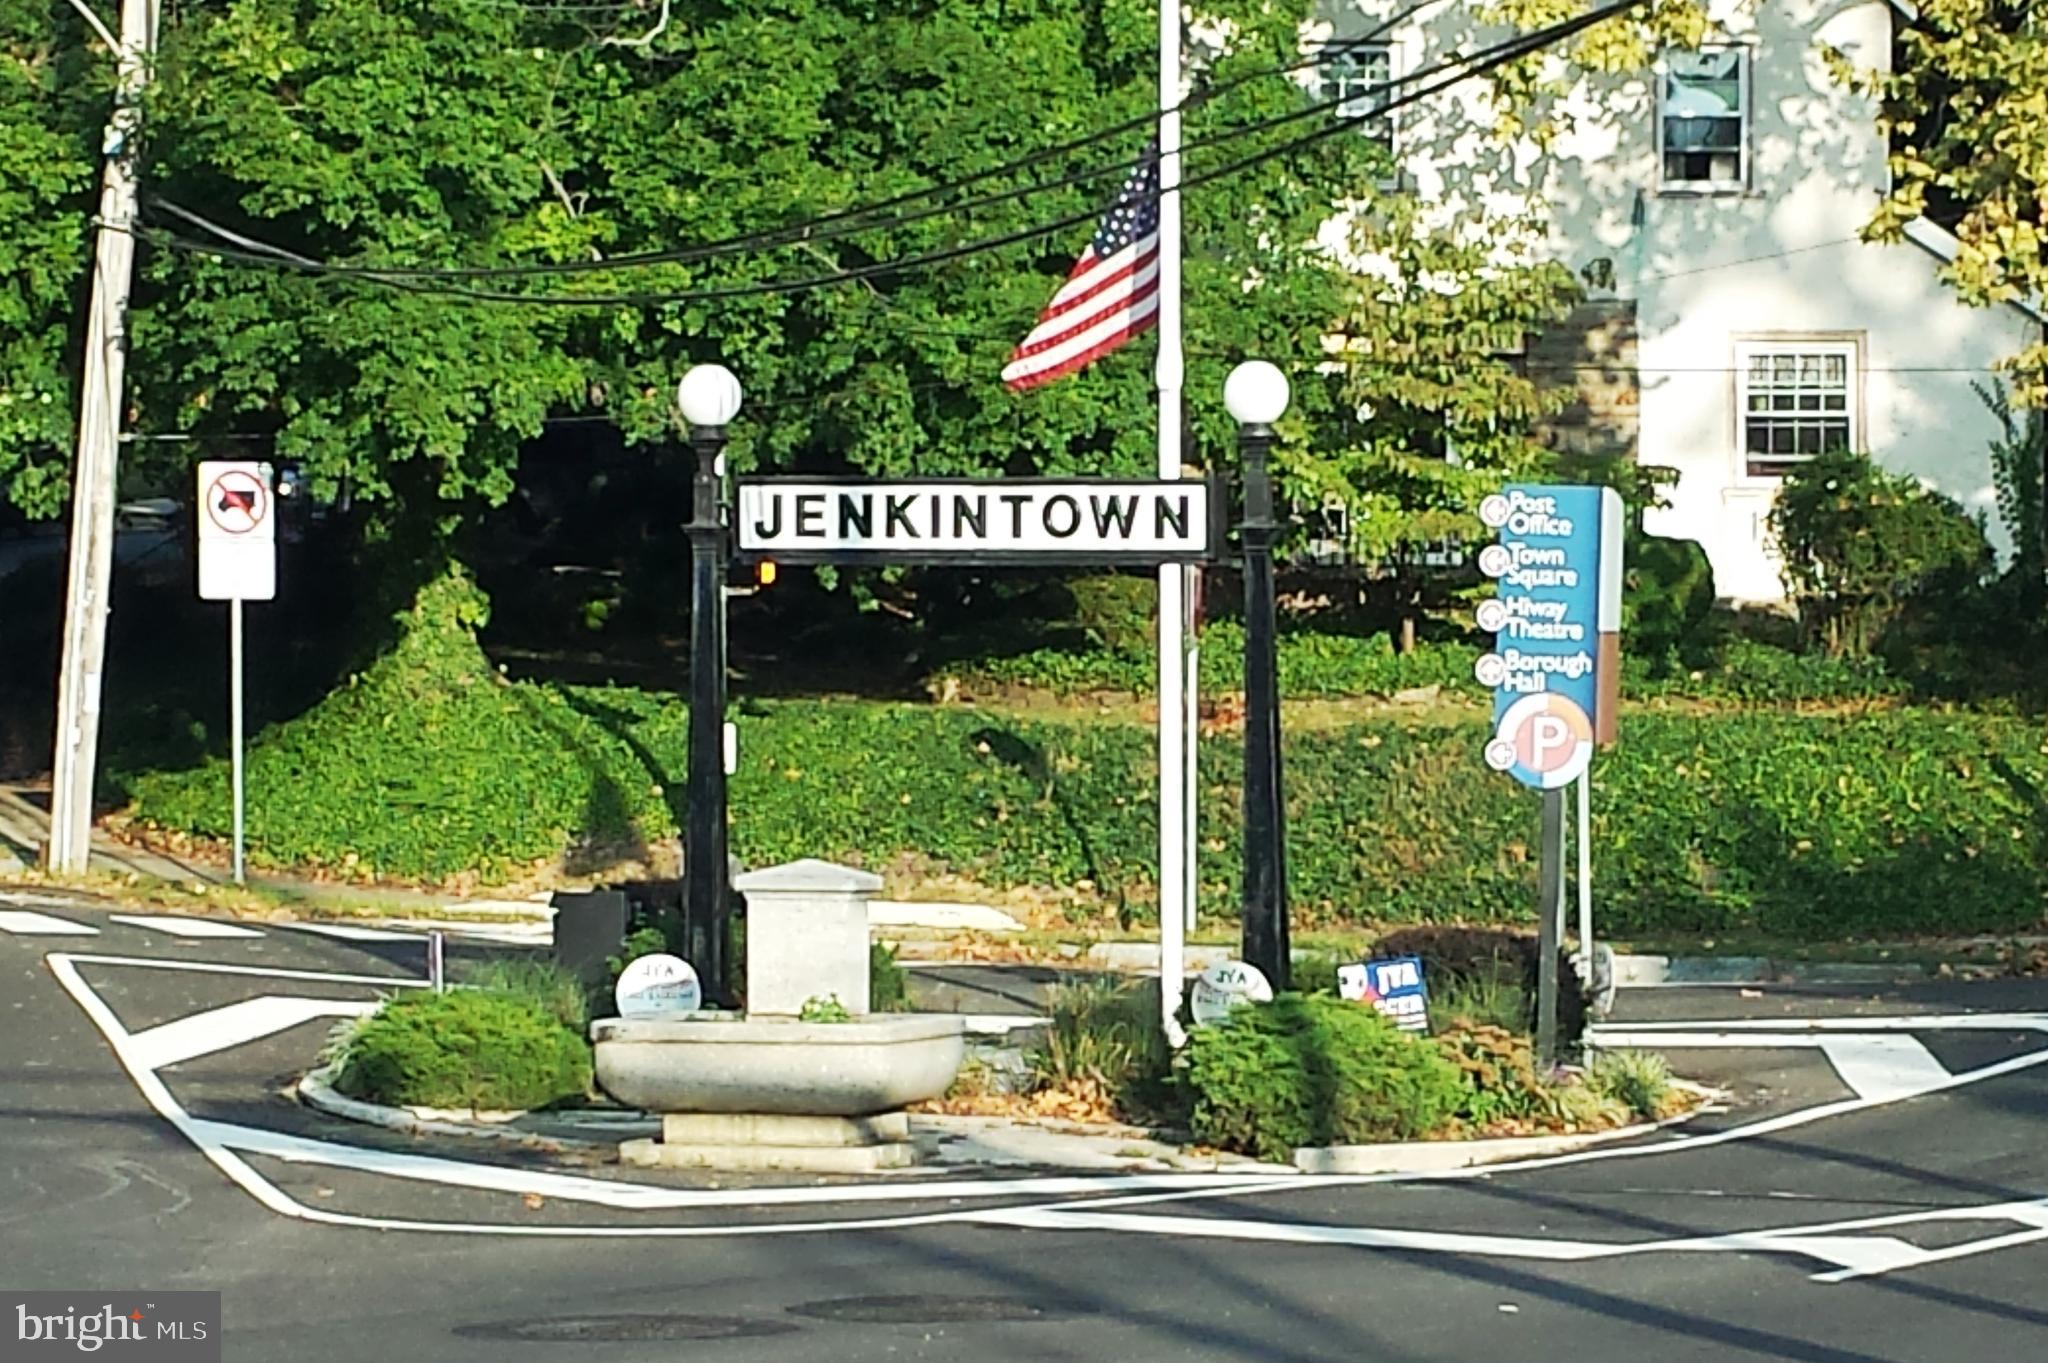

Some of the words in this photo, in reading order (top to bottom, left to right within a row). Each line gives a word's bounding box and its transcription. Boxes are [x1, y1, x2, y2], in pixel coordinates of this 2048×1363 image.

[1509, 491, 1556, 514] Post
[755, 494, 1190, 539] JENKINTOWN
[1508, 514, 1573, 536] Office
[1507, 542, 1565, 565] Town
[1507, 566, 1578, 591] Square
[1506, 597, 1567, 622] Hiway
[1506, 616, 1583, 641] Theatre
[1504, 650, 1592, 678] Borough
[1503, 671, 1545, 692] Hall
[1531, 716, 1568, 769] P
